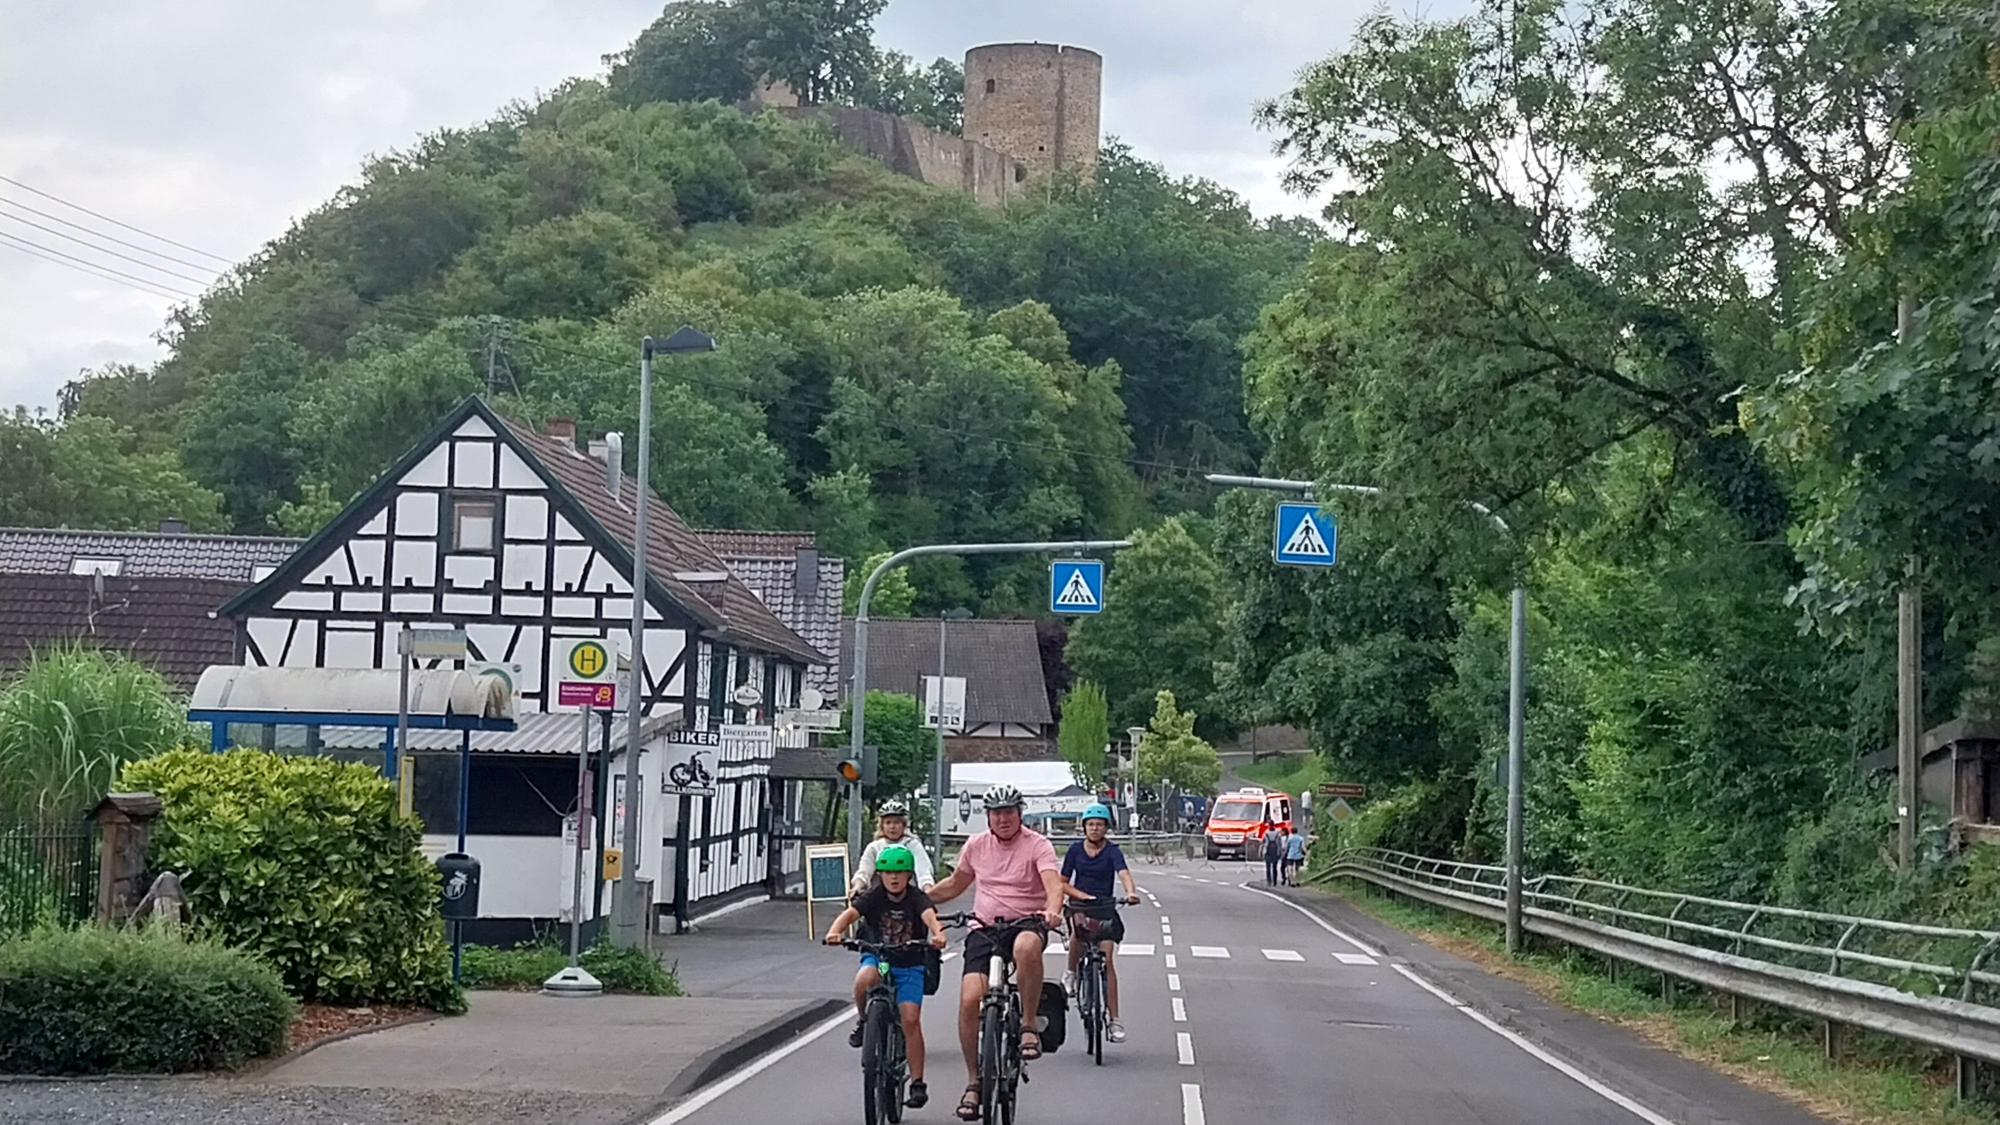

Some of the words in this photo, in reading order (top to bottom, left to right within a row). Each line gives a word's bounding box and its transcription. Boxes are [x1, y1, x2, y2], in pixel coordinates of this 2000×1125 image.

[580, 649, 597, 671] H
[669, 731, 719, 745] BIKER
[723, 727, 769, 737] Biergarten
[663, 785, 715, 796] WILLKOMMEN
